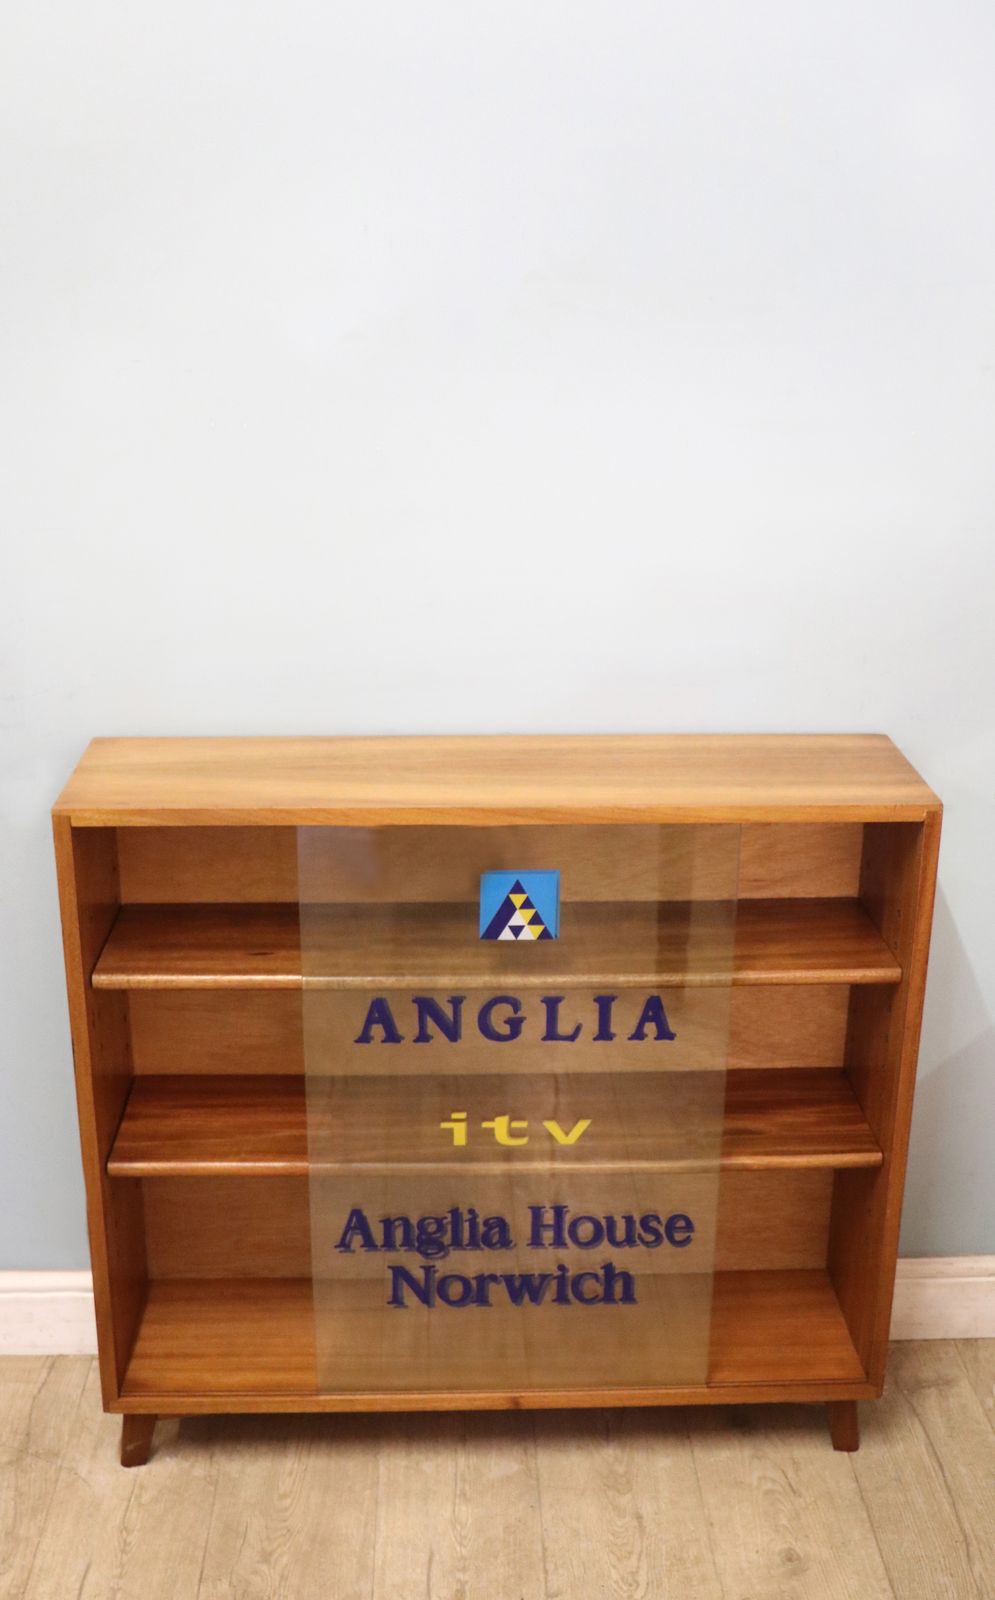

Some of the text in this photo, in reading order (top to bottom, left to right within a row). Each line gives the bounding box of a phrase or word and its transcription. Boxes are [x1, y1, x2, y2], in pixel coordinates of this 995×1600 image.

[354, 995, 677, 1043] ANGLIA
[440, 1112, 592, 1146] itv
[335, 1205, 695, 1258] Anglia House
[388, 1262, 637, 1308] Norwich
